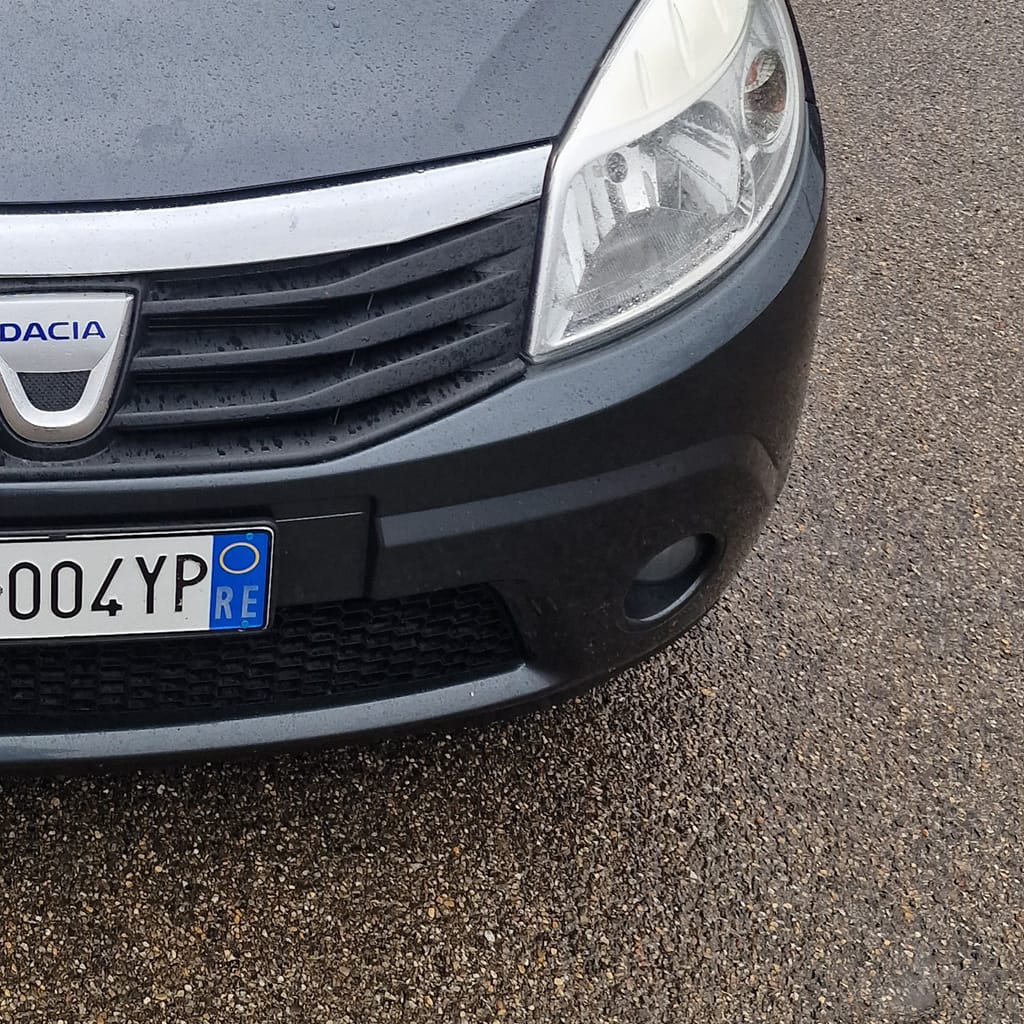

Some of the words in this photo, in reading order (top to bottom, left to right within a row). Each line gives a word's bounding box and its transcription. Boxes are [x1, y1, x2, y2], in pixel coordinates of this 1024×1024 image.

[0, 321, 106, 342] DACIA
[8, 553, 209, 620] 004YP
[214, 584, 258, 621] RE
